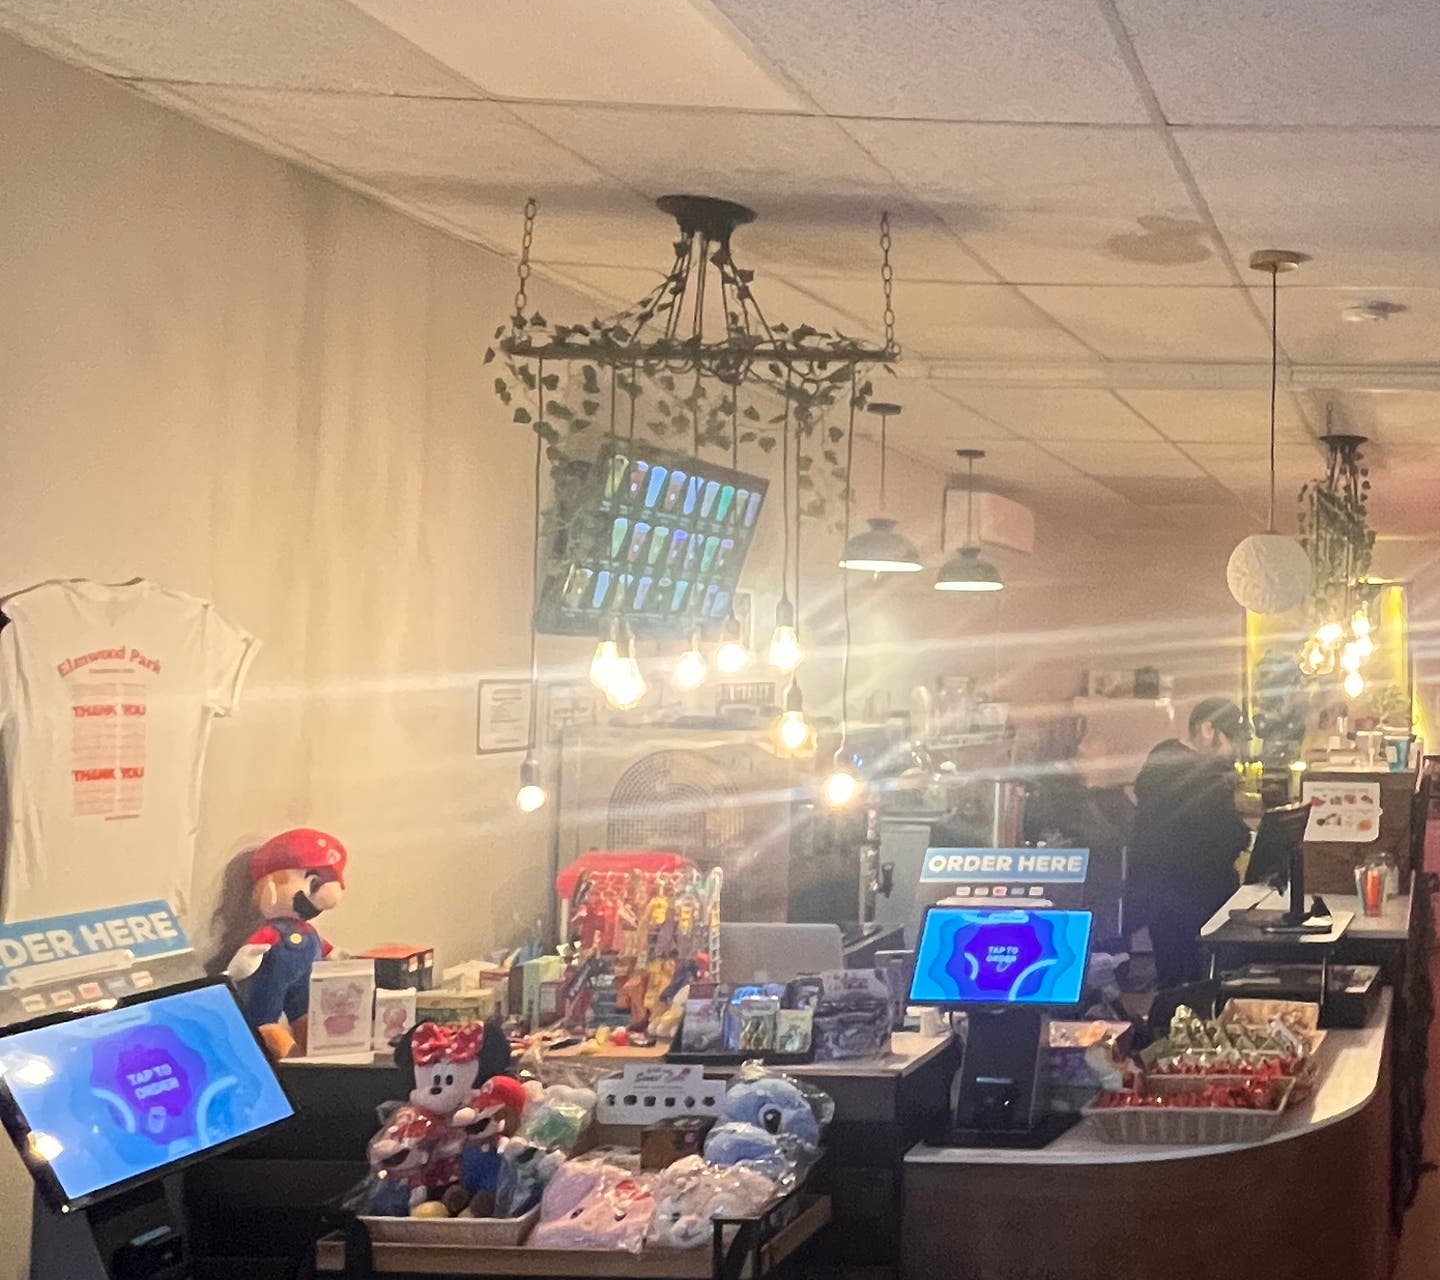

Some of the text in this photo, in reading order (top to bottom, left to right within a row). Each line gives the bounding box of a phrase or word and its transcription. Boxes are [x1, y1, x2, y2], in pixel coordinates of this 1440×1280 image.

[57, 646, 161, 678] Elmwood Park
[72, 704, 146, 717] THANK YOU
[72, 767, 145, 782] THANK YOU
[928, 855, 1083, 873] ORDER HERE
[0, 911, 178, 968] DER HERE
[1006, 946, 1019, 954] TO
